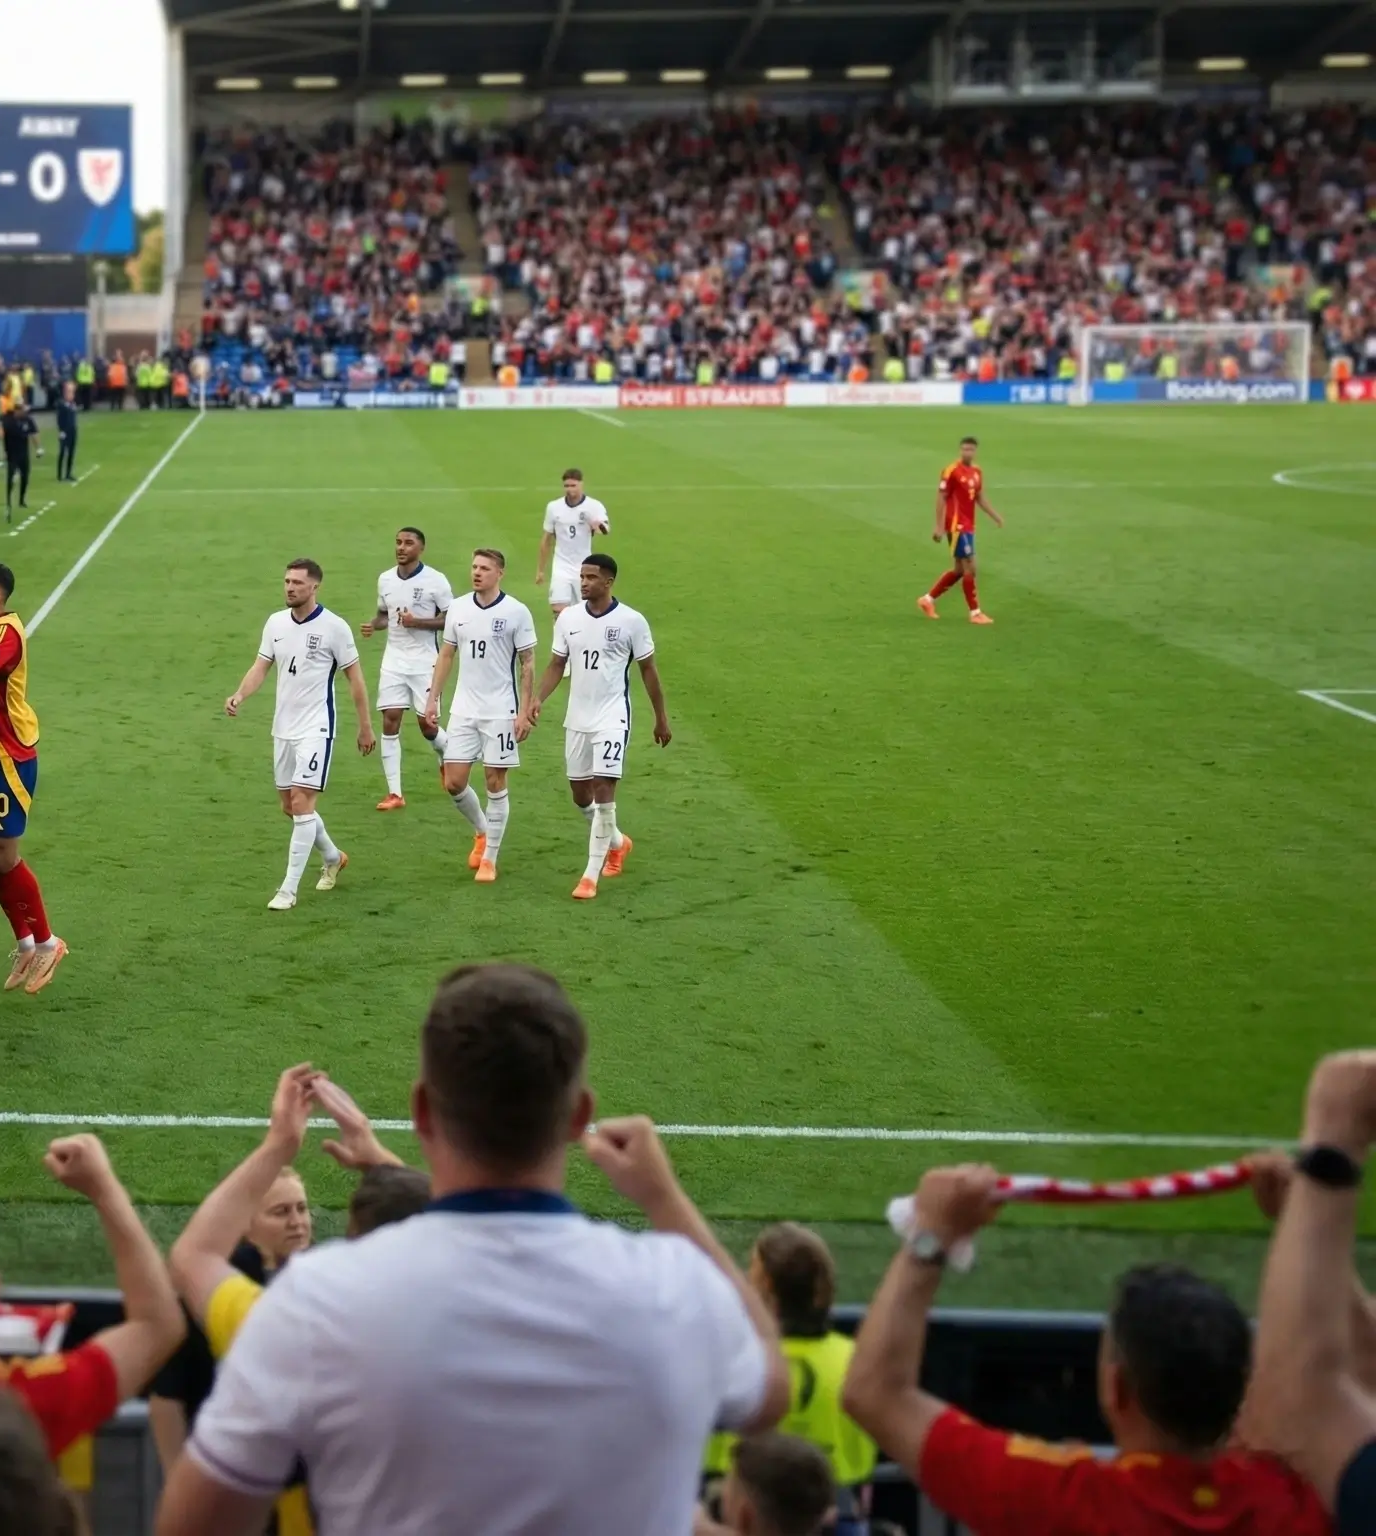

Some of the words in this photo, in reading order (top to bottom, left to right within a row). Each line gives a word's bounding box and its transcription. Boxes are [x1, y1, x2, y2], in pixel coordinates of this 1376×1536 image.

[18, 115, 80, 138] AWAY
[28, 151, 67, 203] 0
[1167, 379, 1296, 403] Booking.com
[569, 525, 576, 539] 9
[469, 640, 487, 659] 19
[288, 656, 297, 676] 4
[582, 650, 600, 670] 12
[497, 732, 514, 752] 16
[603, 740, 622, 761] 22
[309, 752, 318, 771] 6
